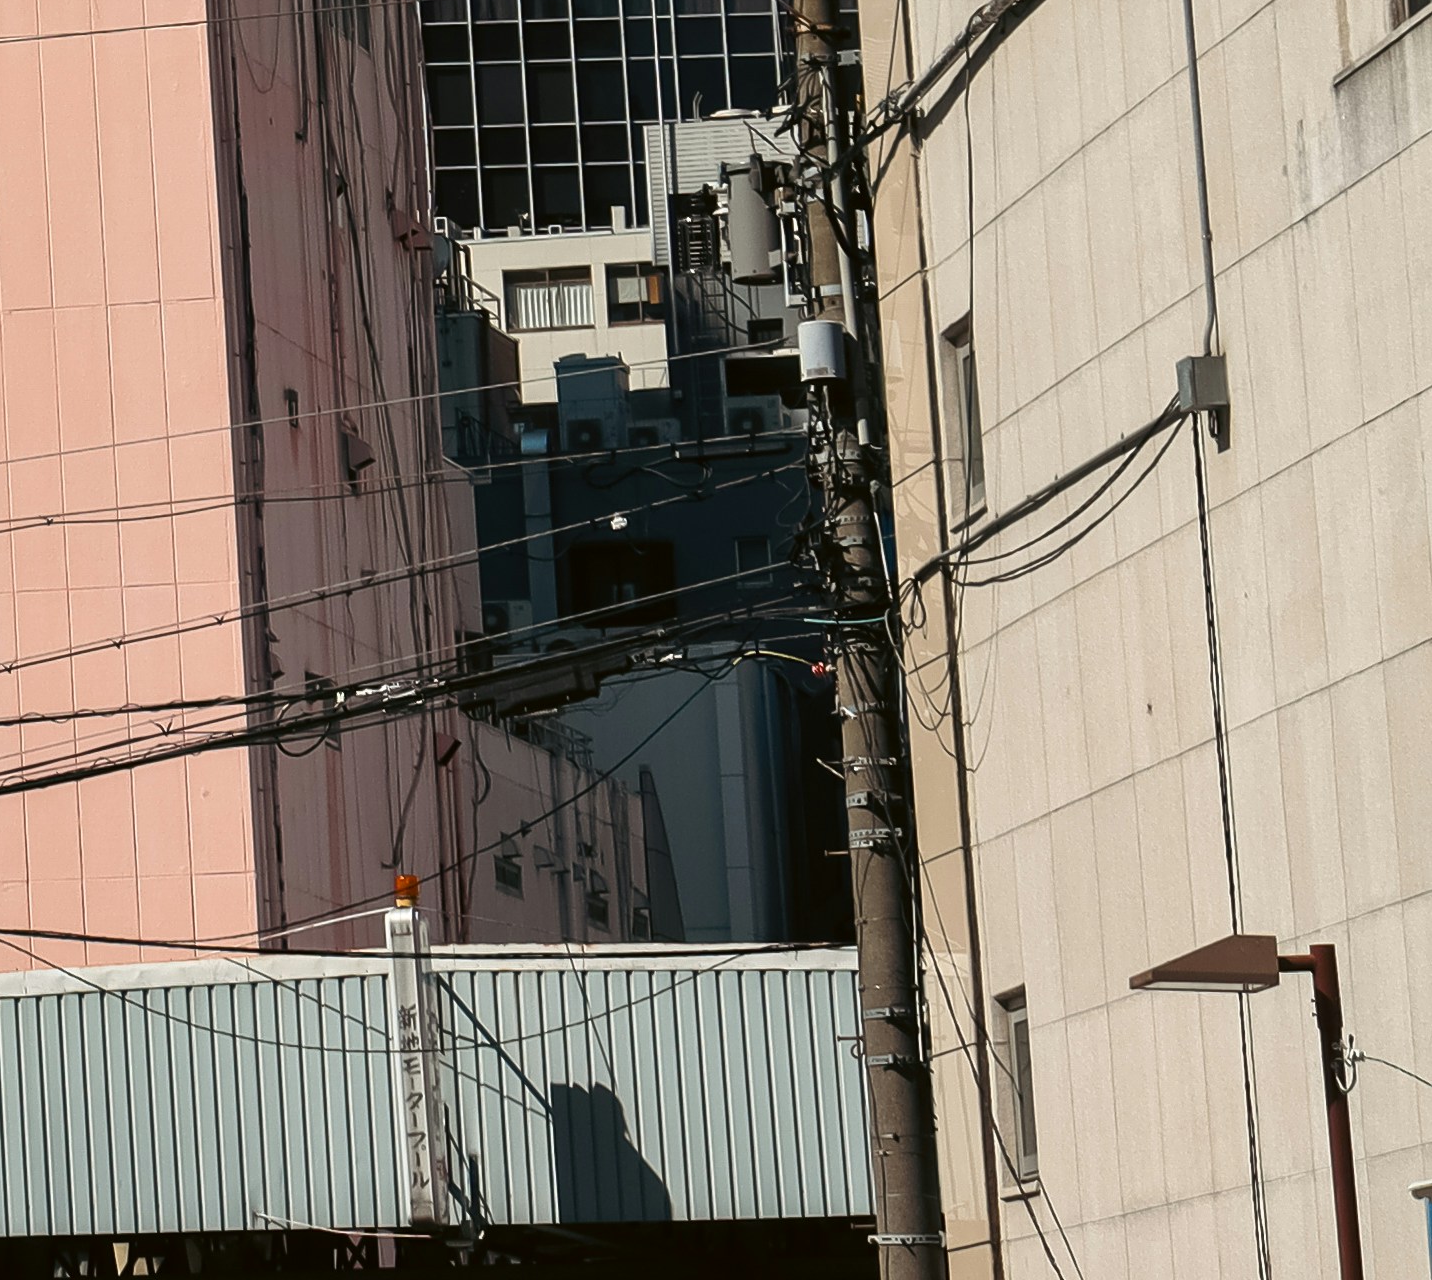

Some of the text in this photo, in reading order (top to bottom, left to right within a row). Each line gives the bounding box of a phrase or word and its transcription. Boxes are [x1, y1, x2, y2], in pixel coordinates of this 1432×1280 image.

[398, 1004, 429, 1189] 新地モータープール
